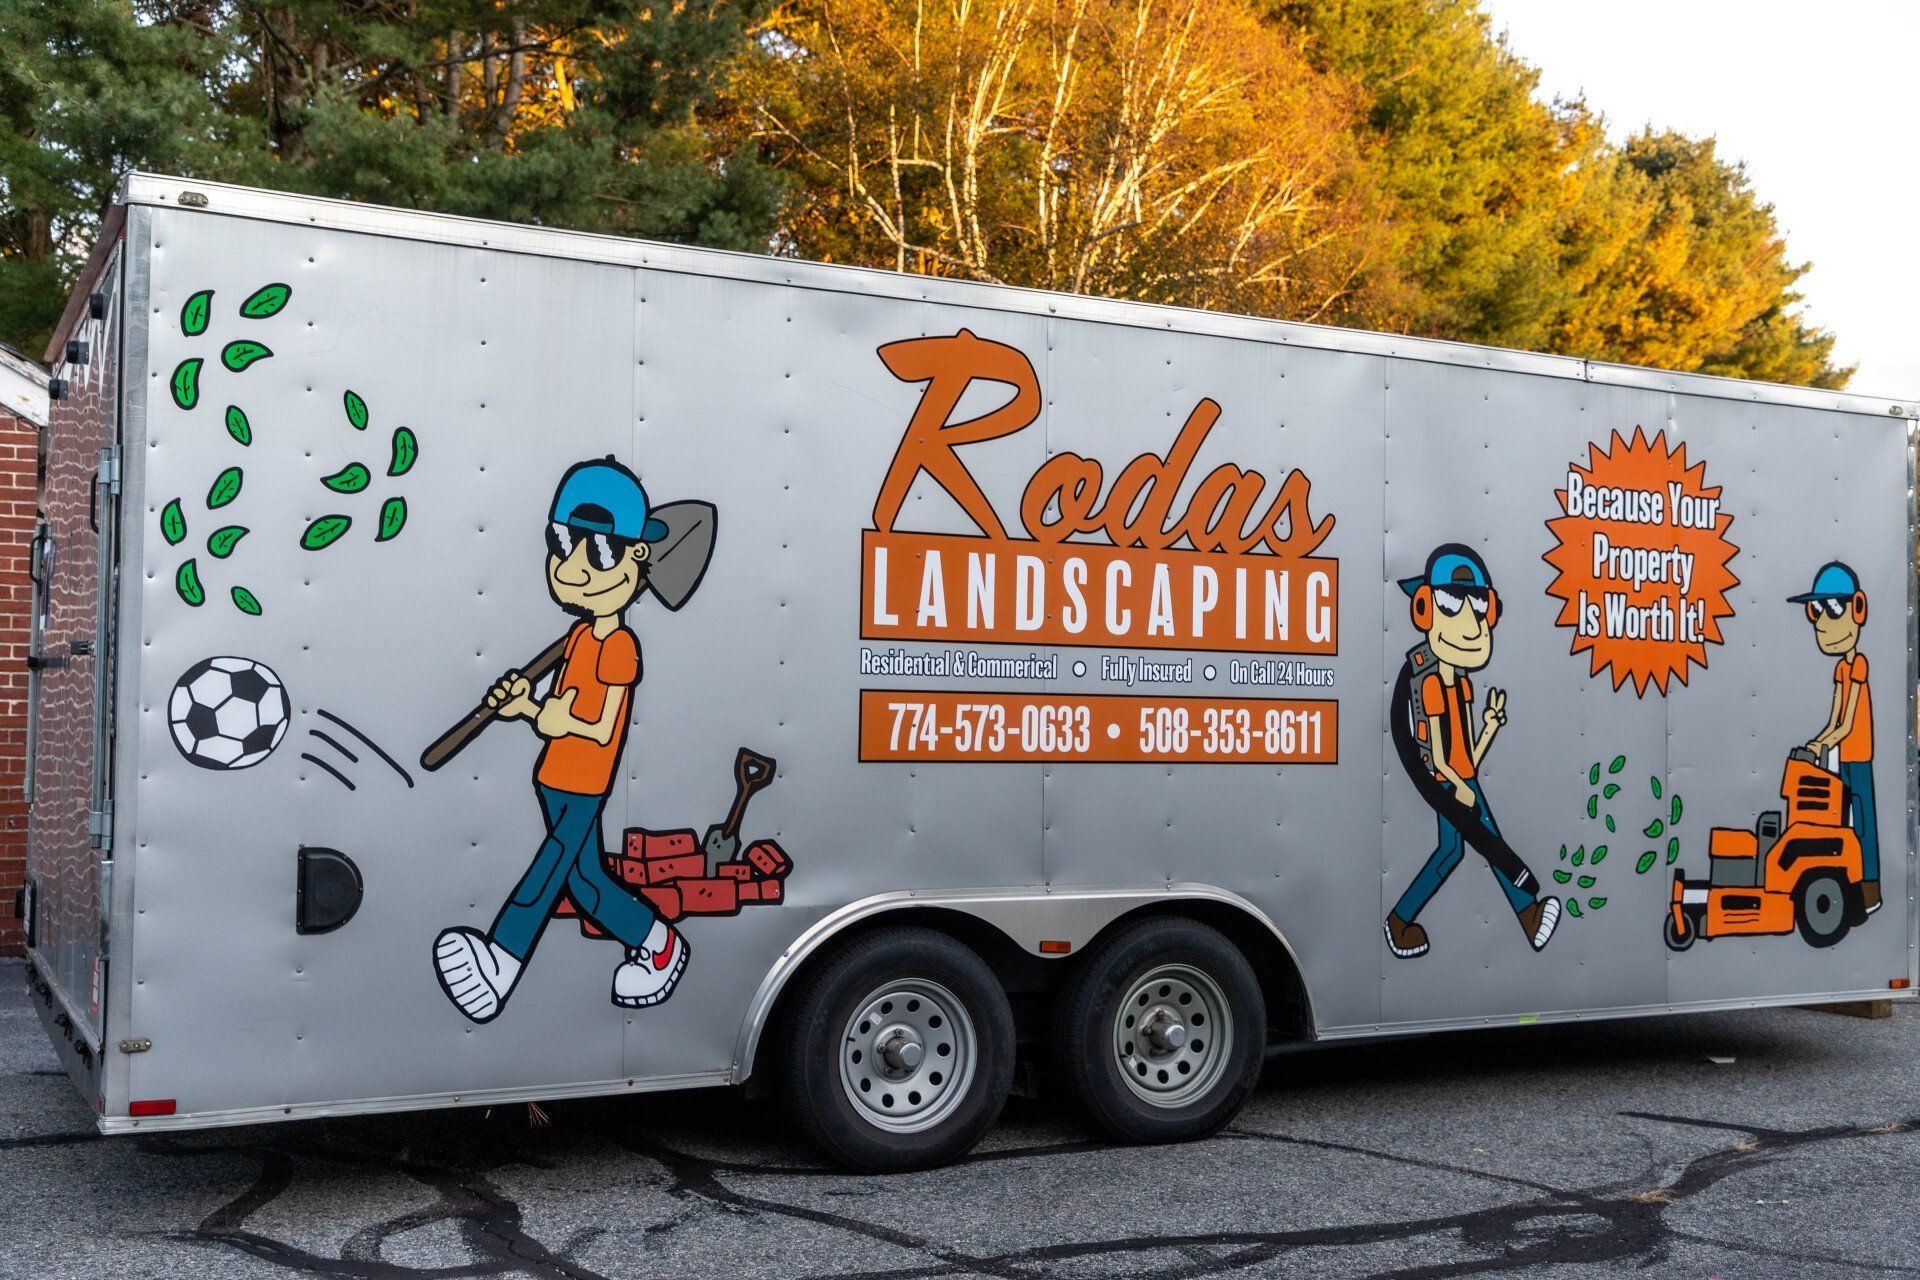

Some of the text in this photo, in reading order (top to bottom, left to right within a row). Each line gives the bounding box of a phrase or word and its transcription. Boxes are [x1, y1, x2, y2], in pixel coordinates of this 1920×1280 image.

[873, 328, 1336, 557] Rodas
[1567, 470, 1720, 530] Because Your
[1593, 532, 1694, 595] Property
[872, 546, 1332, 643] LANDSCAPING
[1578, 589, 1705, 643] Is Worth It!
[860, 648, 1334, 687] Residential & Commerical Fully Insured On Call 24 Hours
[888, 703, 1321, 755] 774-573-0633 508-353-8611
